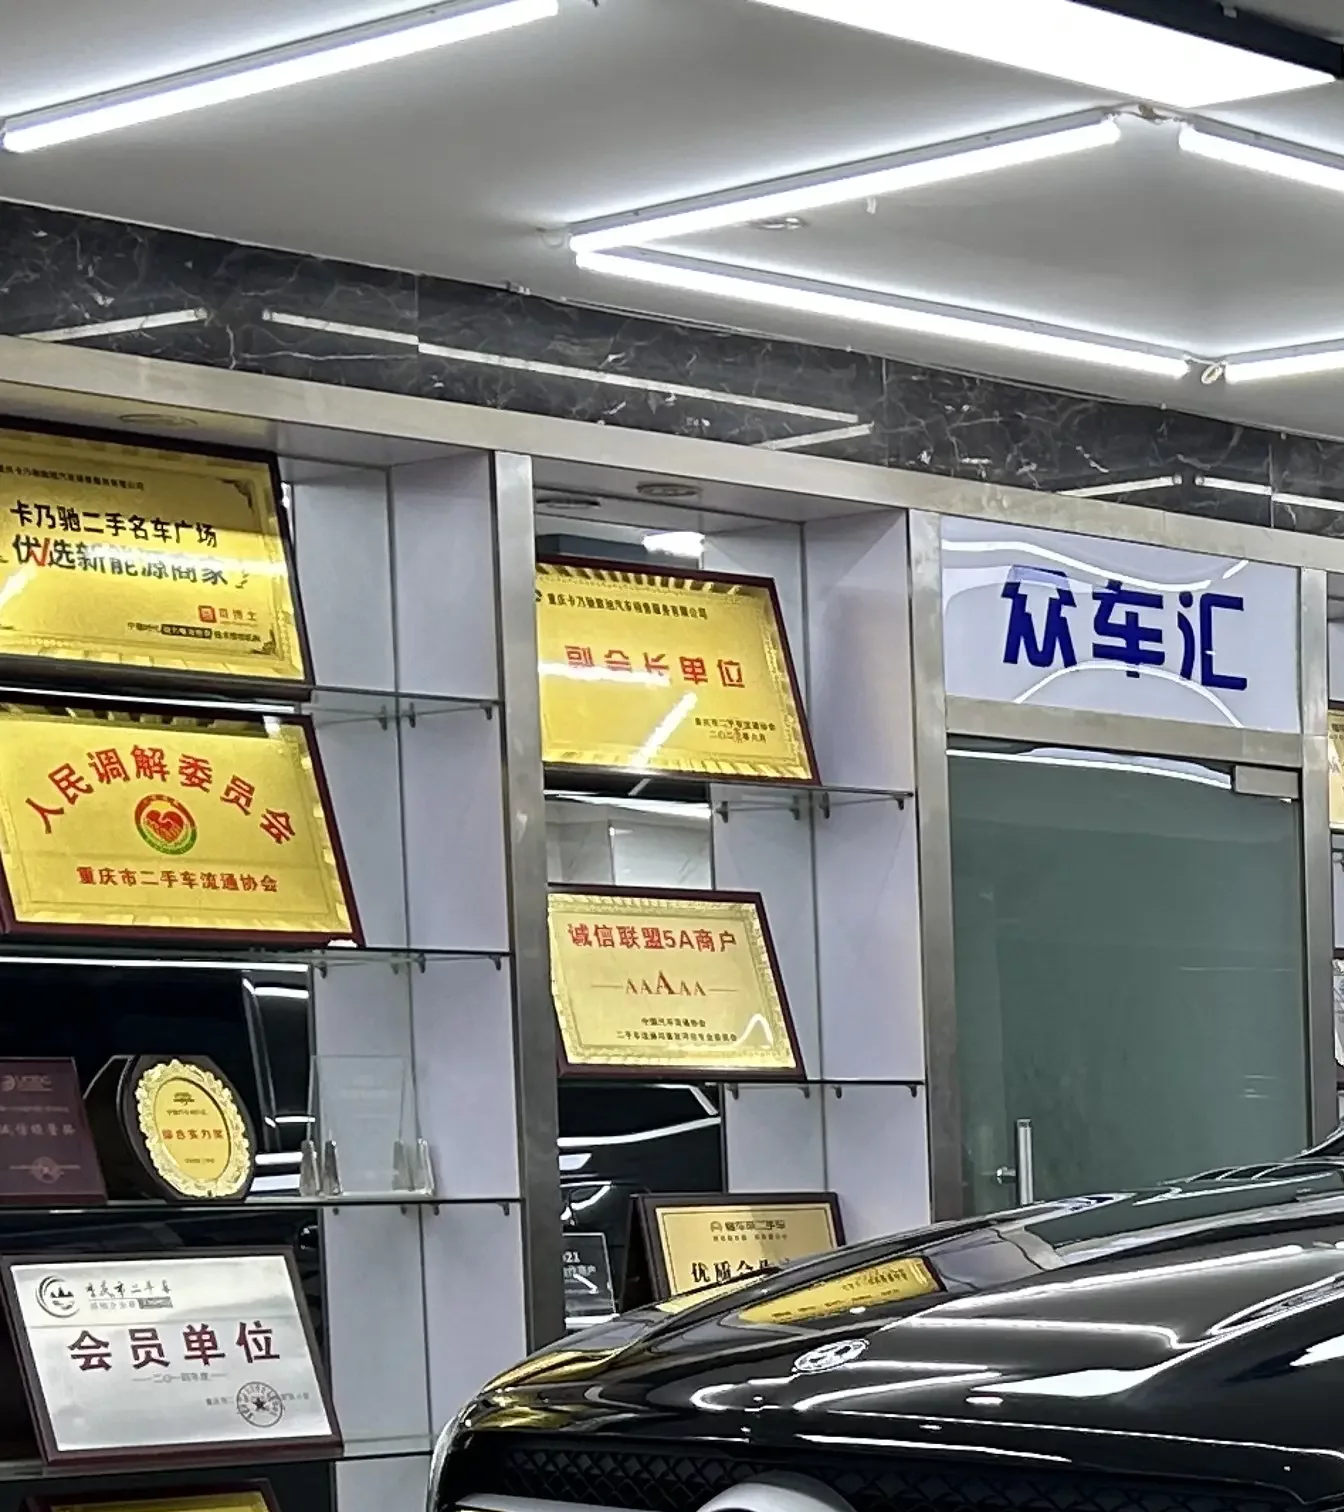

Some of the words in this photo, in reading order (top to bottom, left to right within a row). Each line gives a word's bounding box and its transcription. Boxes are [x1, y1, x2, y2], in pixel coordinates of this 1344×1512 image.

[10, 500, 217, 547] 卡乃驰二手名车广场
[1001, 564, 1247, 691] 众车汇
[25, 744, 296, 844] 人民调解委员会
[76, 866, 279, 893] 重庆市二手车流通协会
[568, 923, 737, 953] 诚信联盟5A商户
[67, 1320, 281, 1372] 会员单位
